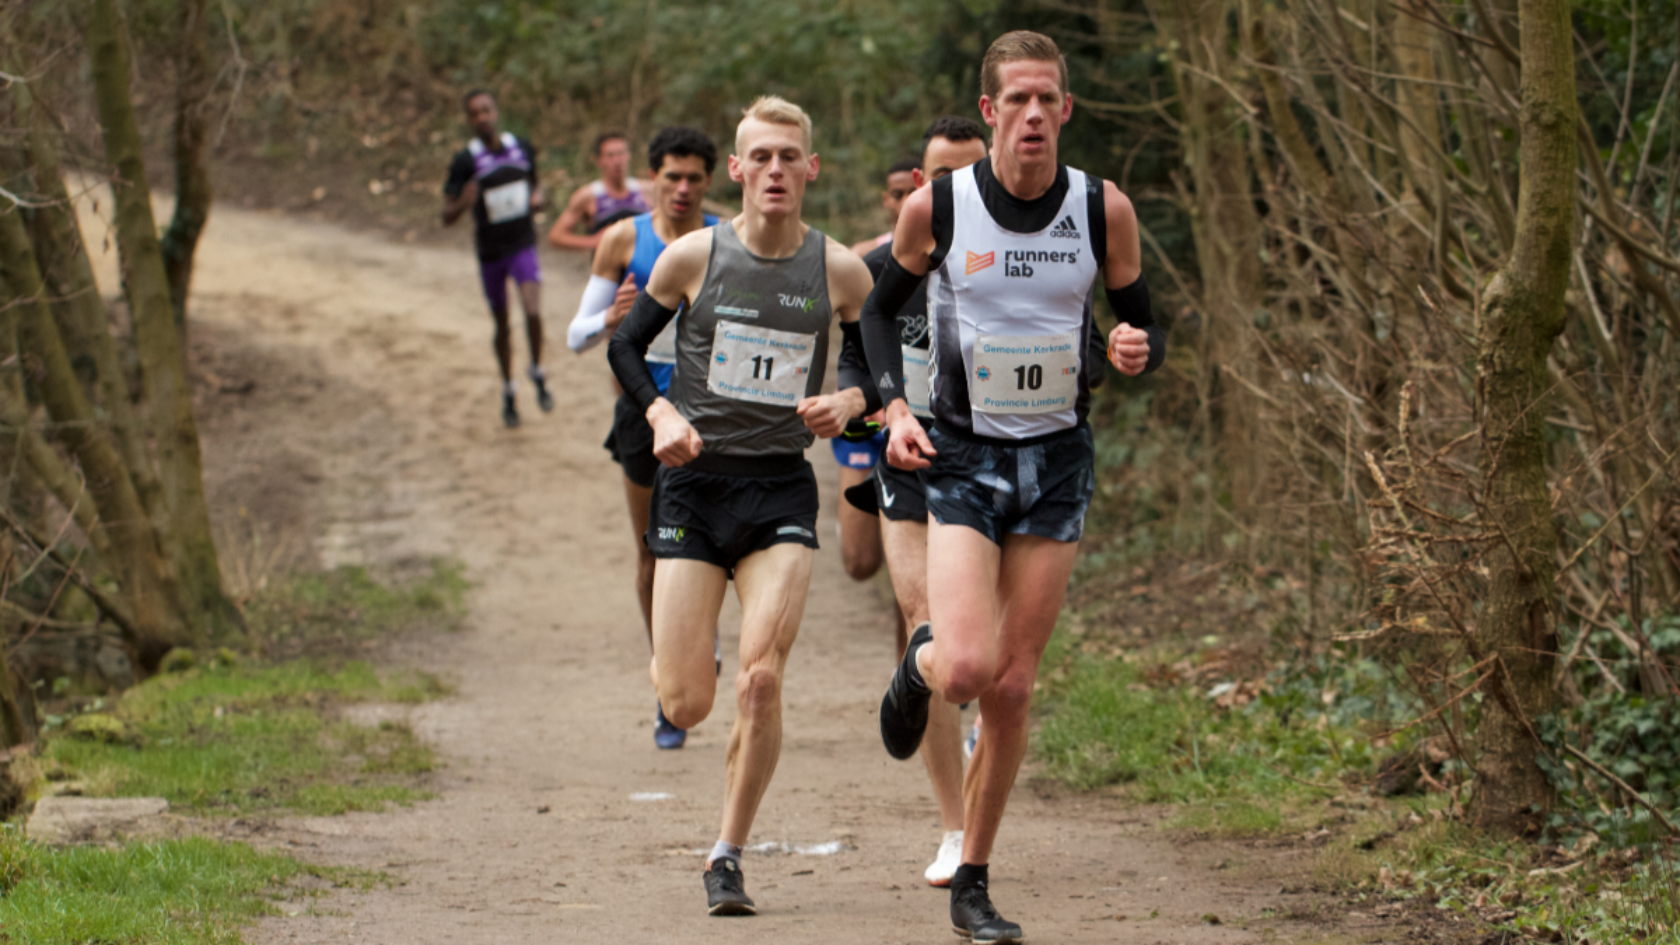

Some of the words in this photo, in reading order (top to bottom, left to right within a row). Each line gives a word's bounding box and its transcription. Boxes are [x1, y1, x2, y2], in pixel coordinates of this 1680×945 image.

[1050, 229, 1081, 239] adidas
[1005, 248, 1080, 263] runners'
[1005, 262, 1033, 277] lab
[983, 344, 1031, 354] Gemeente
[1034, 343, 1071, 354] Kerkrade
[752, 354, 774, 381] 11
[1013, 364, 1042, 390] 10
[718, 381, 759, 396] Provincie
[761, 388, 795, 401] Limburg
[984, 397, 1028, 407] Provincie
[1031, 396, 1066, 407] Limburg
